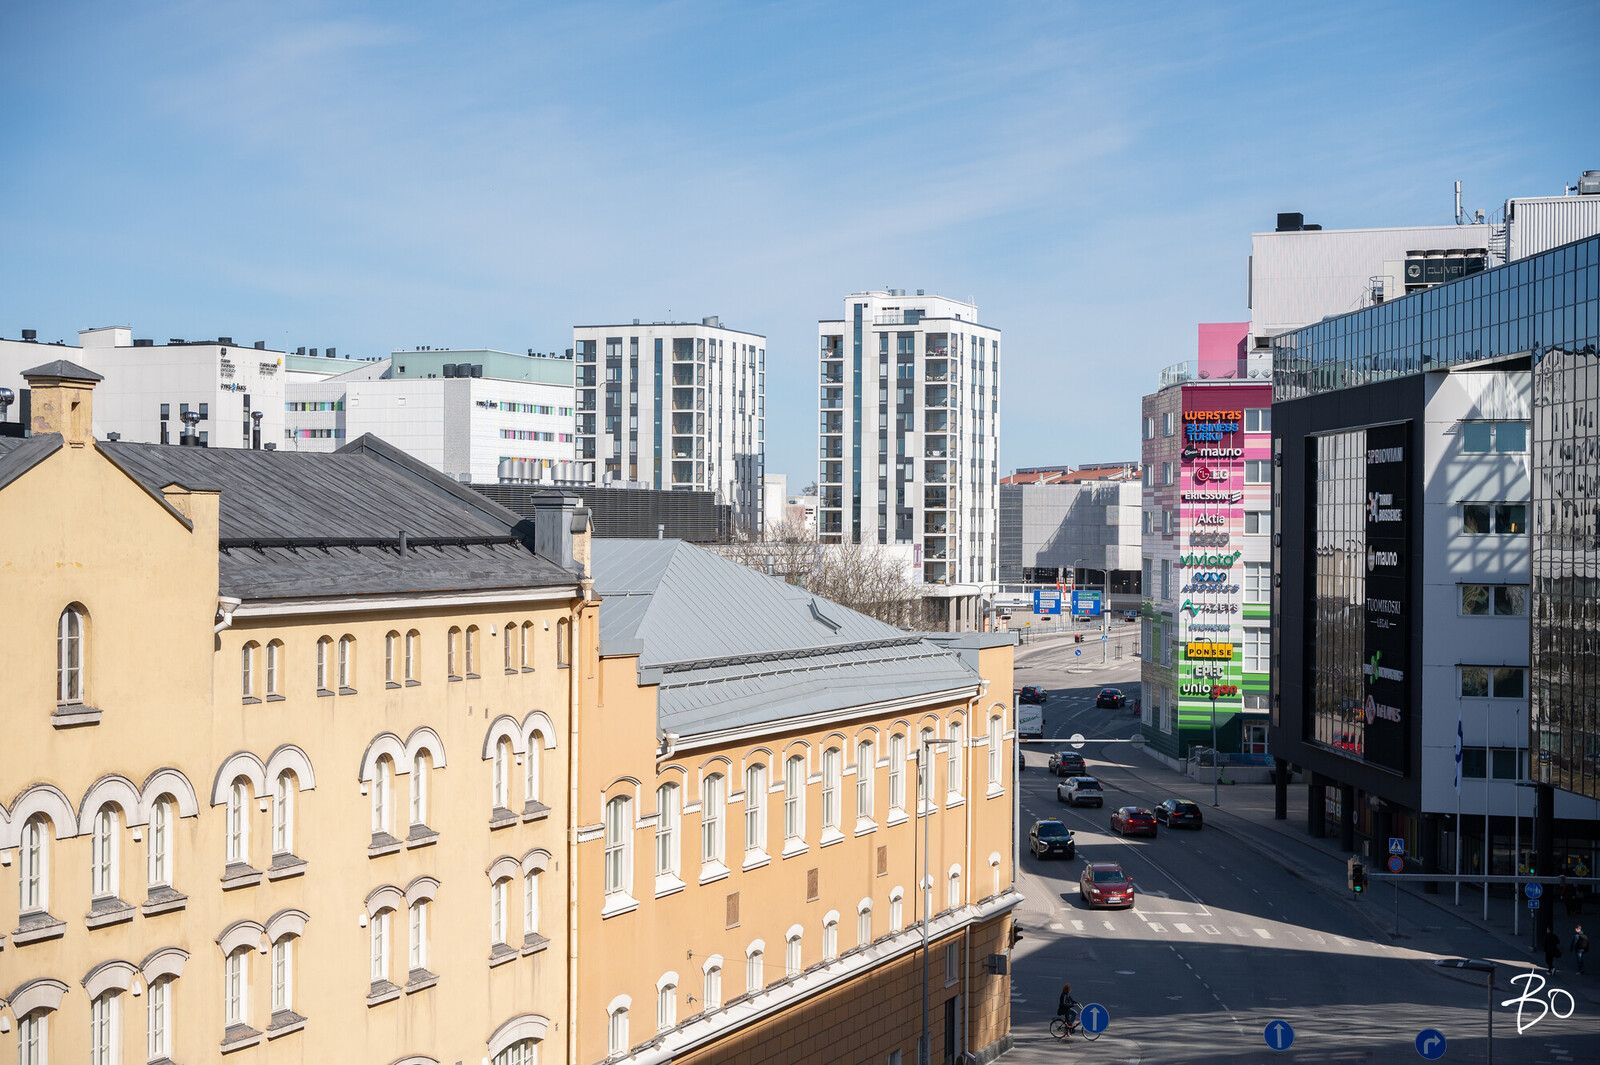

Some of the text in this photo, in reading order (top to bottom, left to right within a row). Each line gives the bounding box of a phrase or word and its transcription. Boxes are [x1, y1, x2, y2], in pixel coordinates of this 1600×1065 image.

[1427, 266, 1463, 275] CLIVET
[1187, 423, 1239, 432] BUSINESS
[1187, 432, 1223, 441] TURKU
[1200, 448, 1242, 457] mauno
[1213, 469, 1230, 480] LG
[1185, 492, 1229, 500] ERICSSON
[1197, 513, 1226, 524] Aktia
[1180, 552, 1234, 566] vivicta
[1375, 551, 1398, 566] mauno
[1204, 603, 1239, 611] AZETS
[1366, 598, 1401, 614] TUOMIKOSKI
[1195, 665, 1225, 676] EPEC
[1182, 682, 1238, 698] uniogen
